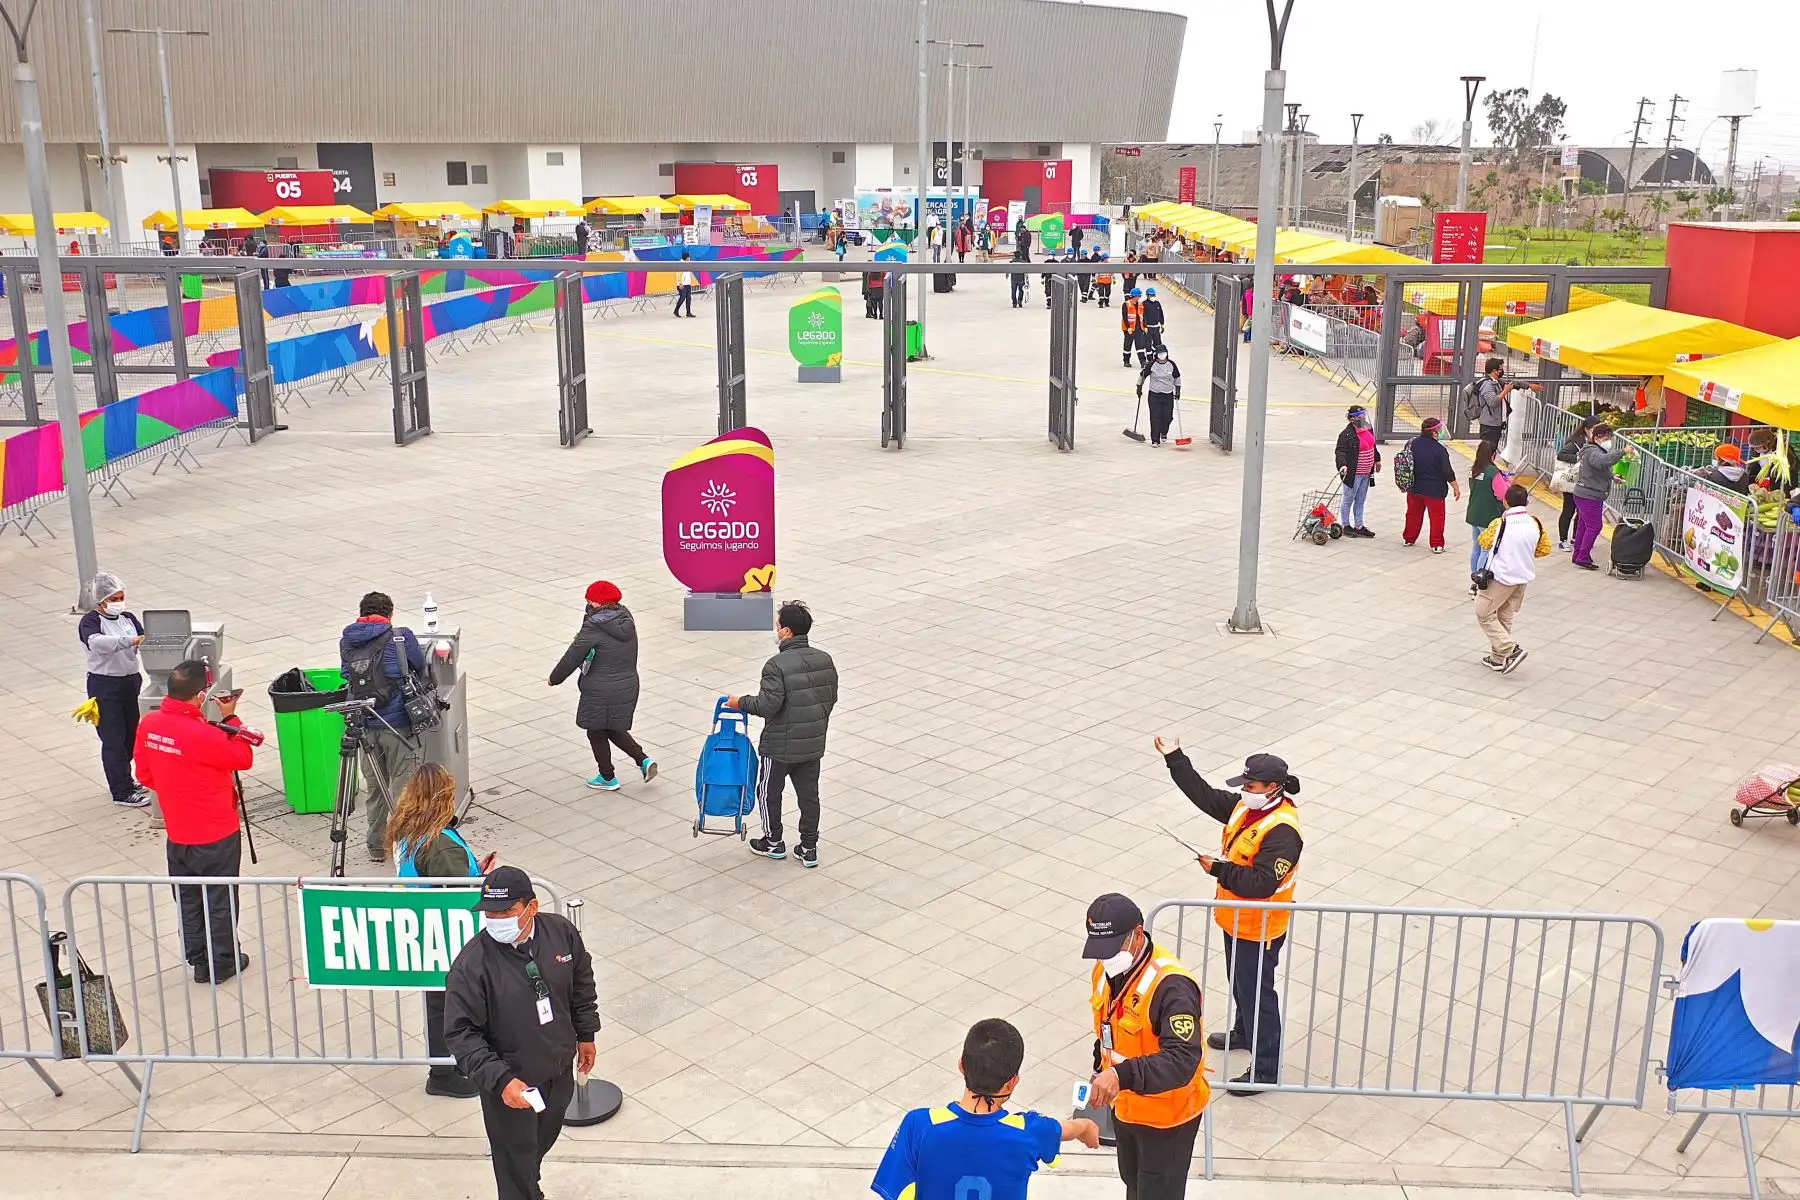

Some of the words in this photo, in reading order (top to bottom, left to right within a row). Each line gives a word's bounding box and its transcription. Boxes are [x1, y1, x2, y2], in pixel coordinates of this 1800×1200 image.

[741, 172, 758, 187] 03
[1046, 167, 1056, 178] 01
[276, 181, 302, 198] 05
[797, 330, 836, 340] LEGADO
[1688, 509, 1708, 529] Vende
[678, 521, 760, 539] LEGADO
[679, 541, 723, 552] Seguimos
[724, 541, 760, 552] jugando
[1277, 863, 1289, 875] SP
[320, 905, 487, 972] ENTRAD
[1174, 1020, 1193, 1034] SP
